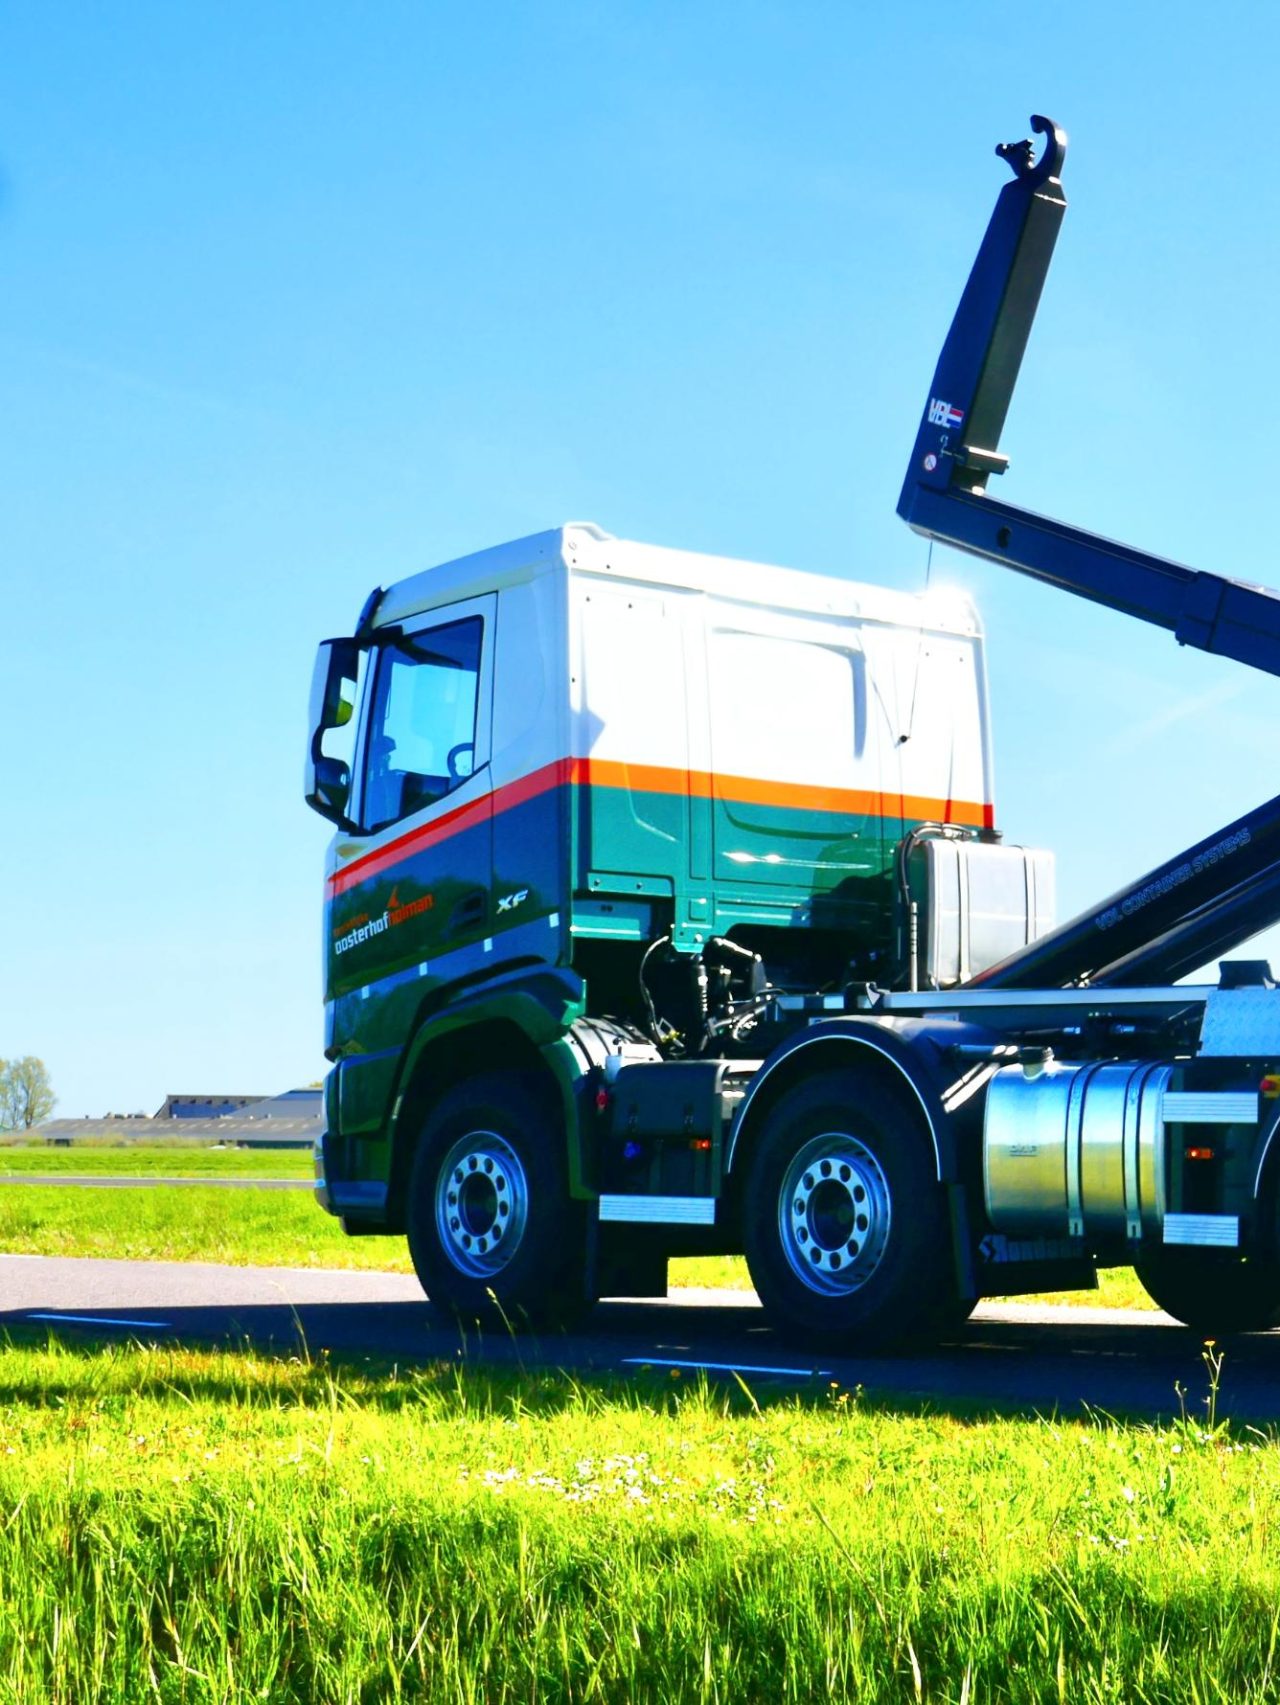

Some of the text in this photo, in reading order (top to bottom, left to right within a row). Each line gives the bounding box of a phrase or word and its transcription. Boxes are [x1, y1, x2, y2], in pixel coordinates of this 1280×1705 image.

[928, 397, 952, 429] VDL
[1095, 827, 1251, 931] VDL CONTAINER SYSTEMS
[496, 889, 529, 914] XF
